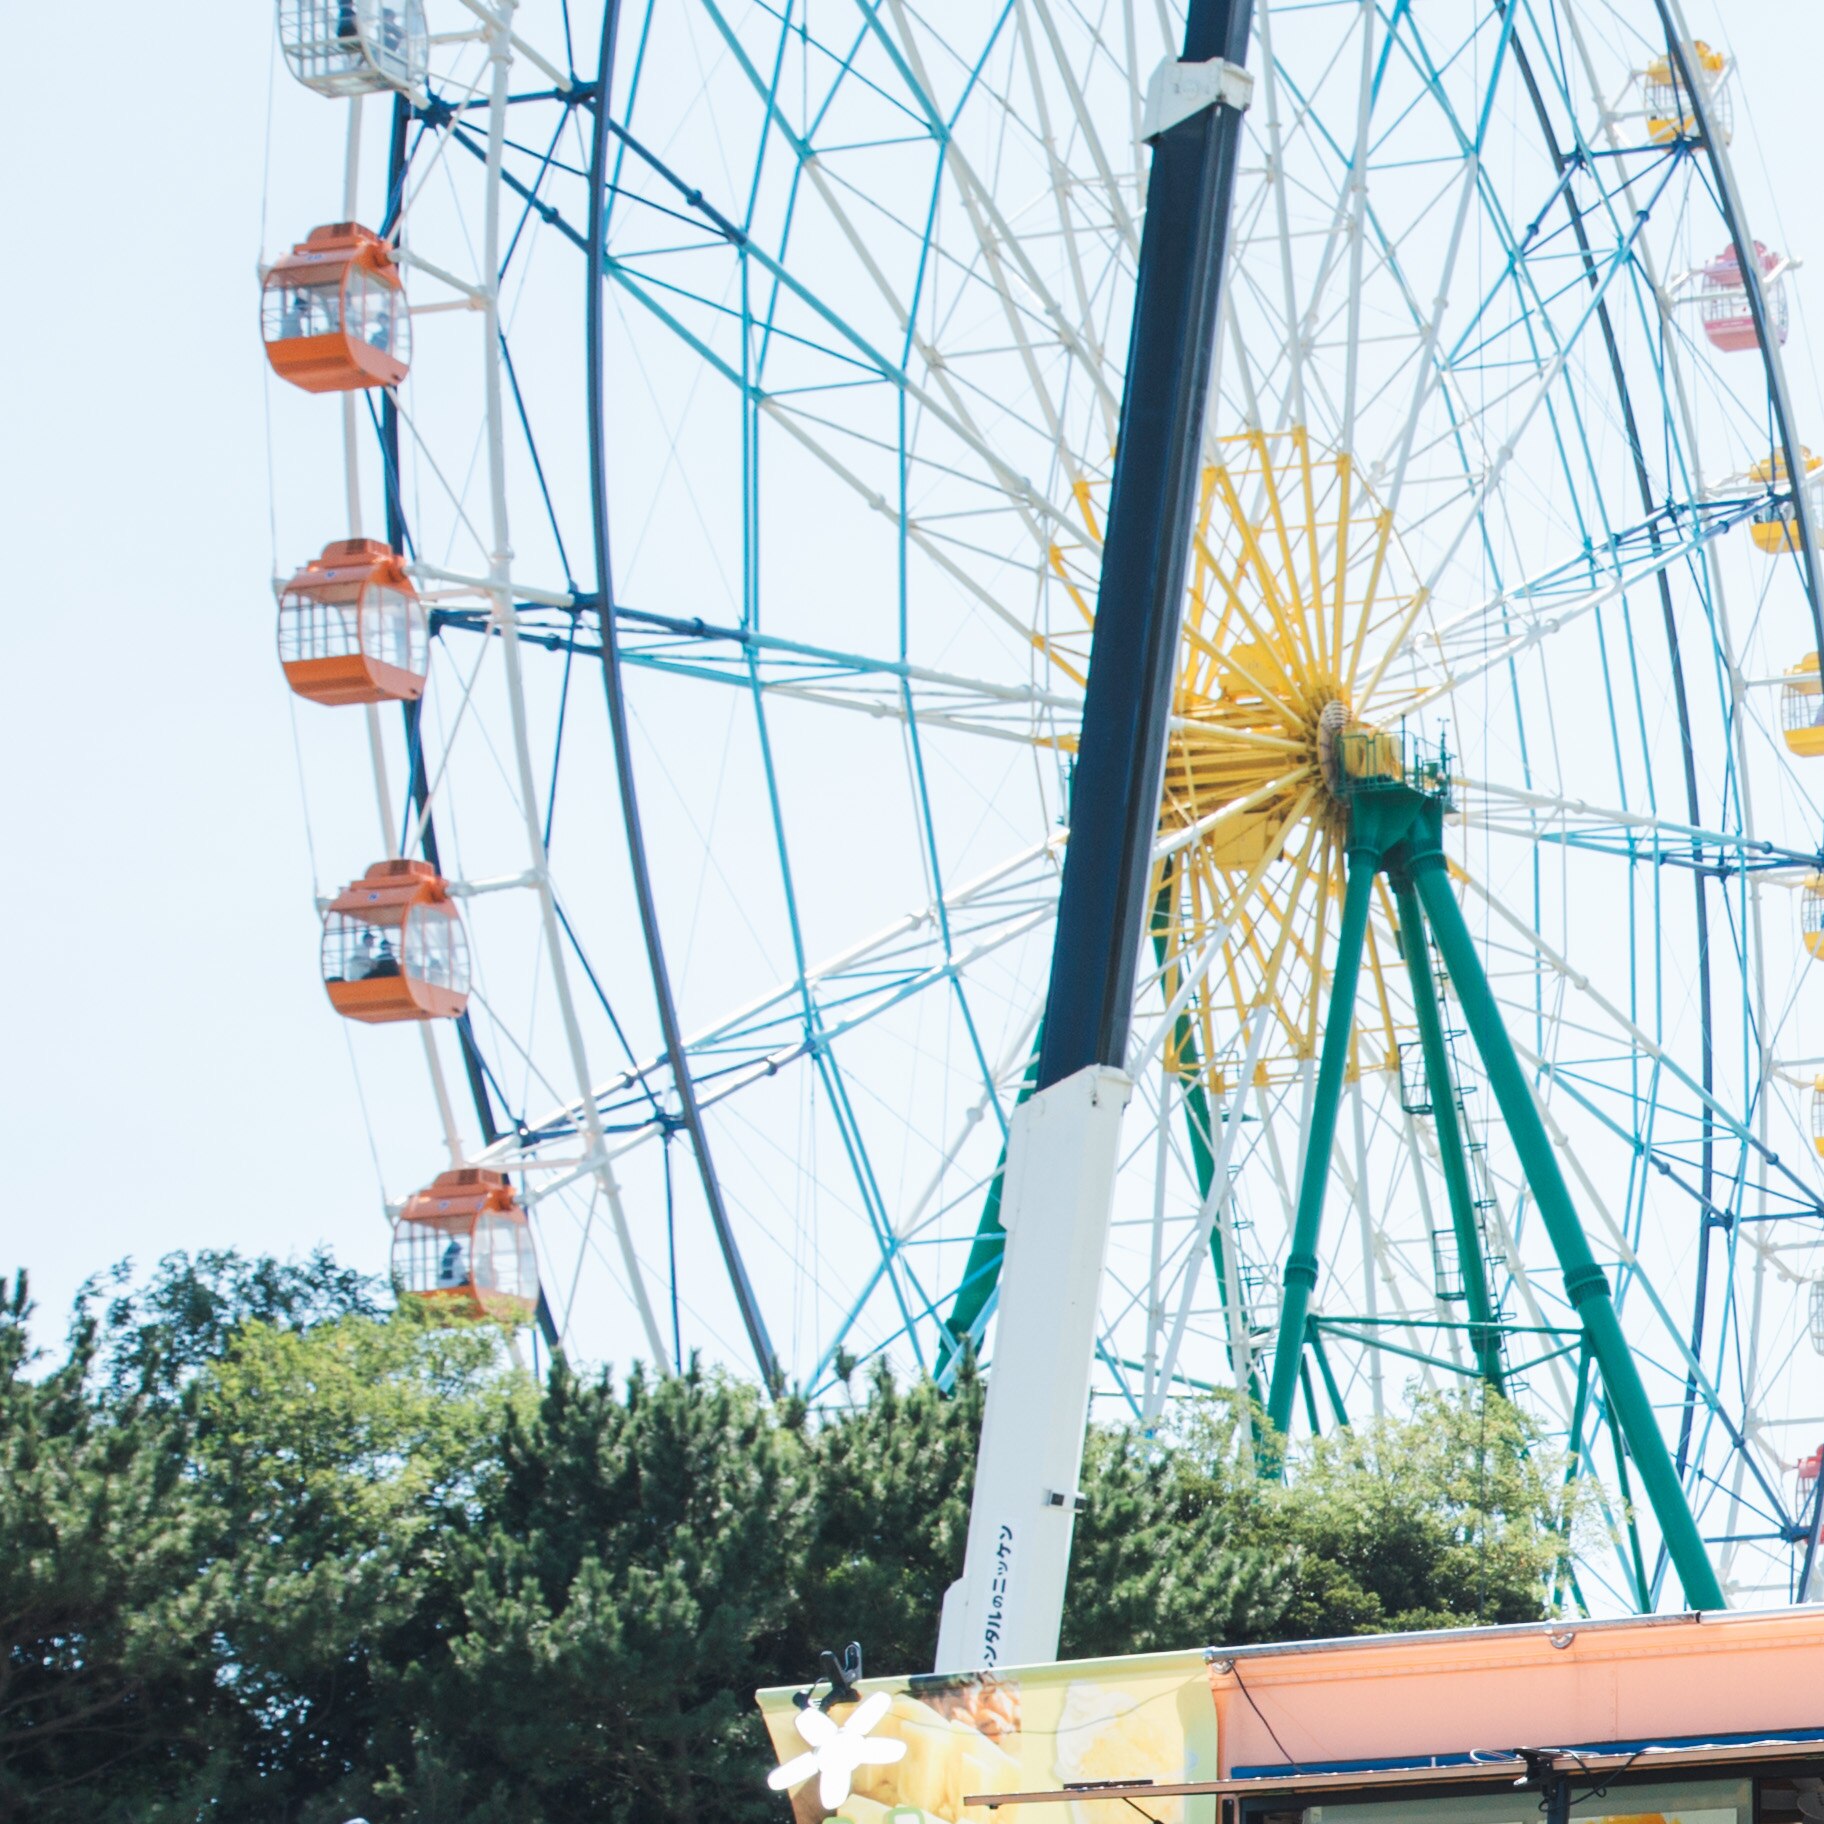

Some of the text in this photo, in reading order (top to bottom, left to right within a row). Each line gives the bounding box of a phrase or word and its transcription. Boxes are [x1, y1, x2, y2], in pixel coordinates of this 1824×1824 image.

[983, 1525, 1013, 1668] ンタルのニッケン
